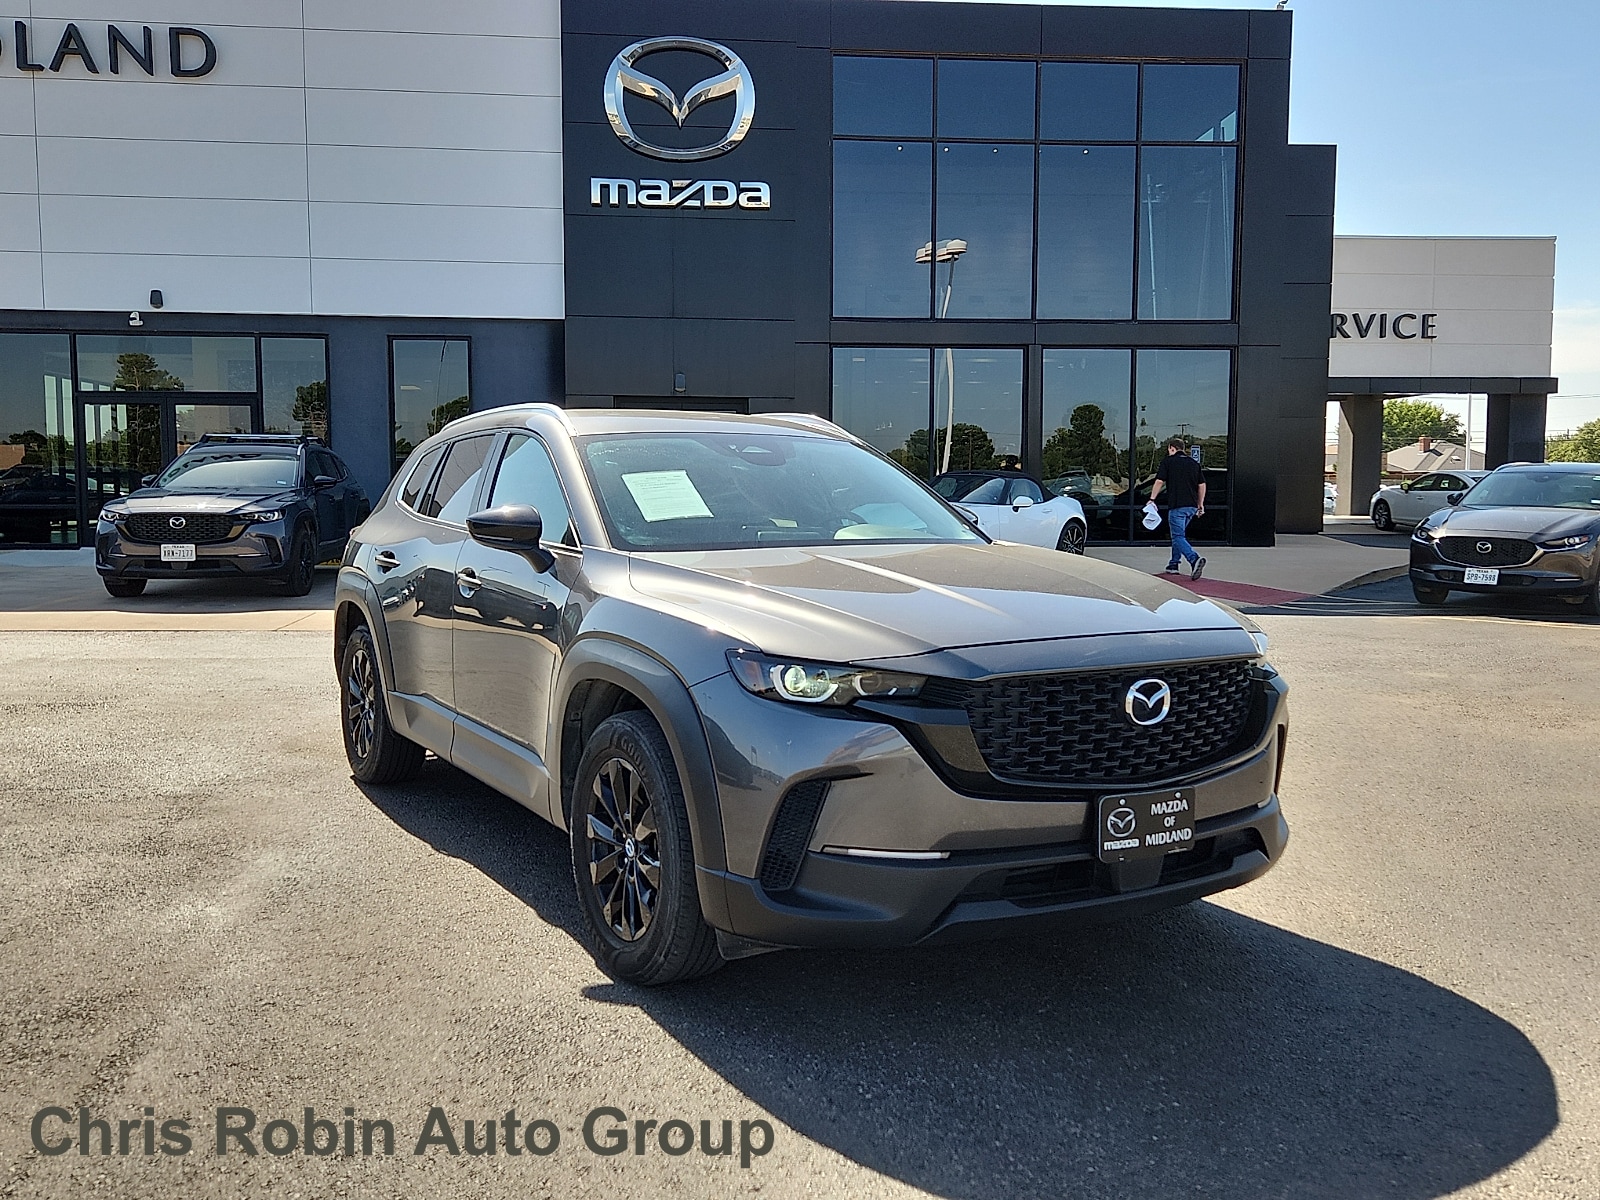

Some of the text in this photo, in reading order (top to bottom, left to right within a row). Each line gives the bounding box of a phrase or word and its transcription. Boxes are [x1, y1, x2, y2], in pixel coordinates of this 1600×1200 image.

[0, 20, 217, 77] LAND
[1150, 799, 1188, 816] MAZDA
[1163, 816, 1176, 828] OF
[1145, 828, 1192, 847] MIDLAND
